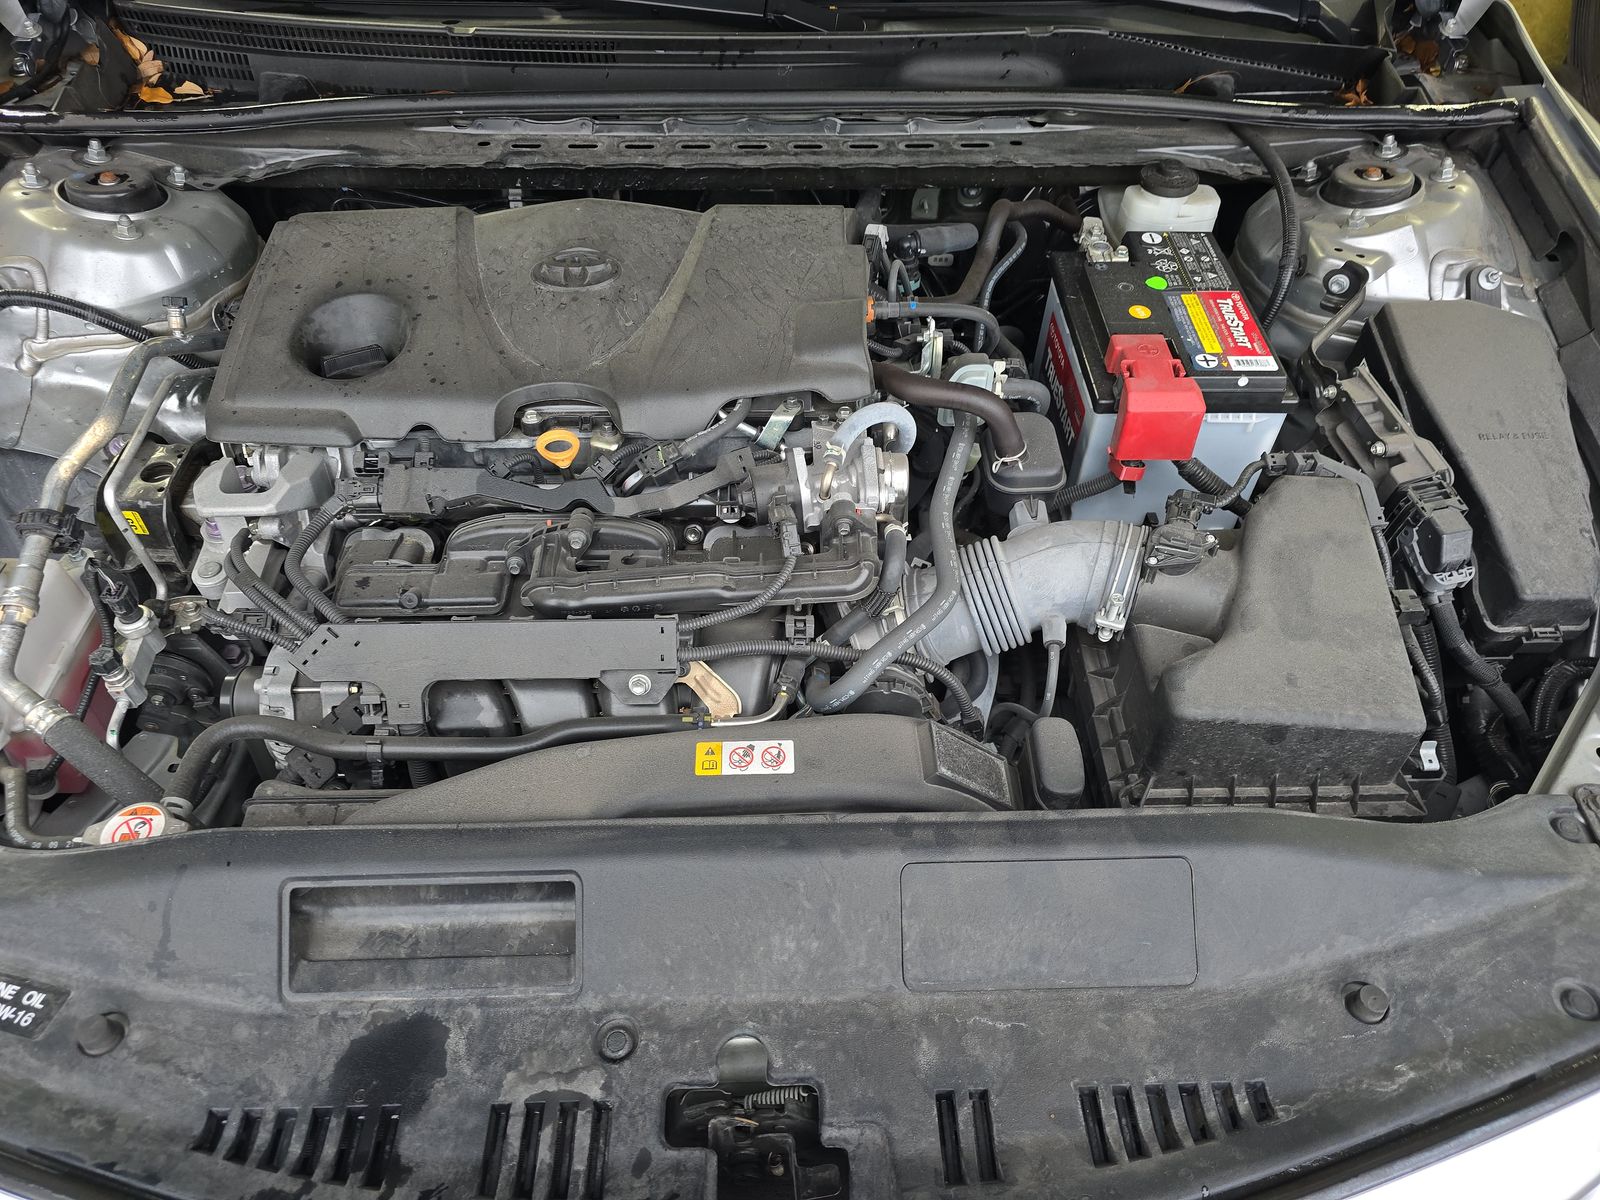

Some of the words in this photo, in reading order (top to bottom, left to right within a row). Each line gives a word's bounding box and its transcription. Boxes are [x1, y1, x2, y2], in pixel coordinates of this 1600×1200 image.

[1235, 299, 1250, 321] TOYOTA
[1216, 298, 1253, 350] TRUESTART
[1044, 346, 1076, 447] TRUESTART
[1478, 432, 1510, 441] RELAY
[21, 990, 47, 1010] OIL
